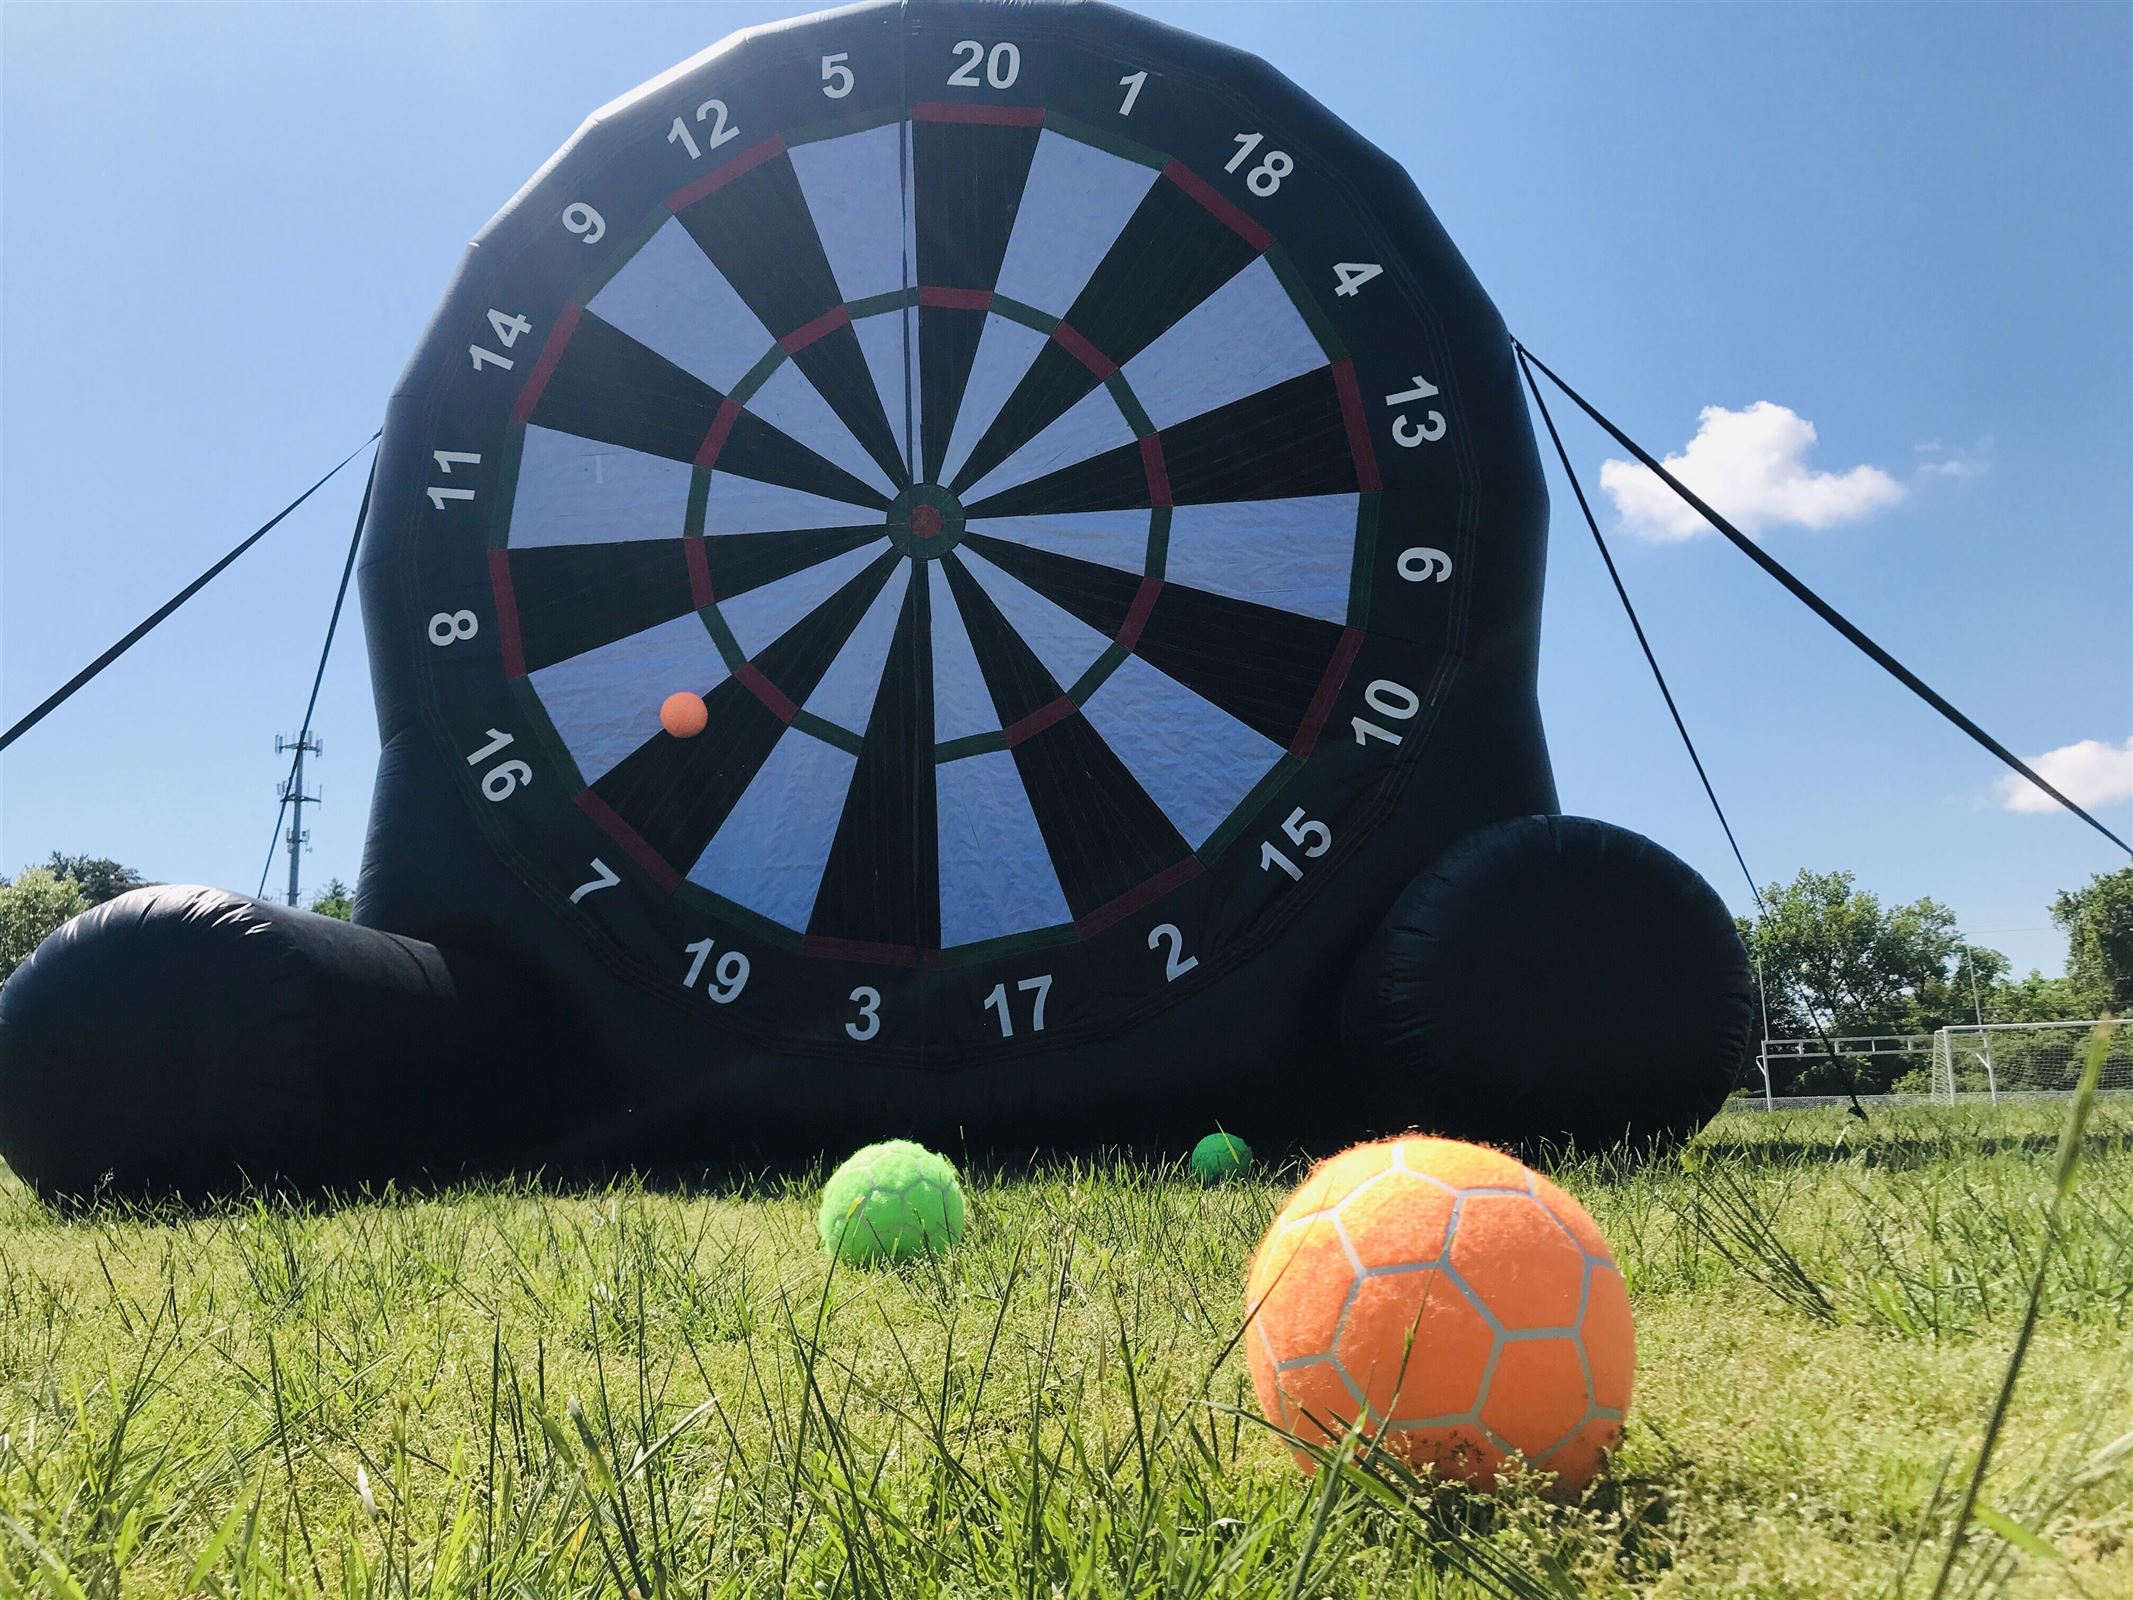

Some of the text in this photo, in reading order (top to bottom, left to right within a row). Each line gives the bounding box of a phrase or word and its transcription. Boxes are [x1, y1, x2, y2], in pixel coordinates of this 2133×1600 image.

[822, 53, 854, 98] 5
[947, 41, 1020, 88] 20
[1119, 71, 1147, 115] 1
[667, 99, 739, 159] 12
[1225, 133, 1293, 197] 18
[563, 203, 605, 243] 9
[1333, 263, 1383, 296] 4
[469, 309, 532, 370] 14
[1386, 376, 1446, 447] 13
[427, 451, 481, 509] 11
[1397, 548, 1452, 582] 6
[429, 610, 478, 646] 8
[1351, 680, 1419, 745] 10
[467, 729, 532, 801] 16
[1261, 807, 1331, 881] 15
[570, 858, 620, 904] 7
[683, 938, 749, 1003] 19
[1148, 924, 1198, 982] 2
[846, 986, 880, 1040] 3
[984, 975, 1052, 1037] 17
